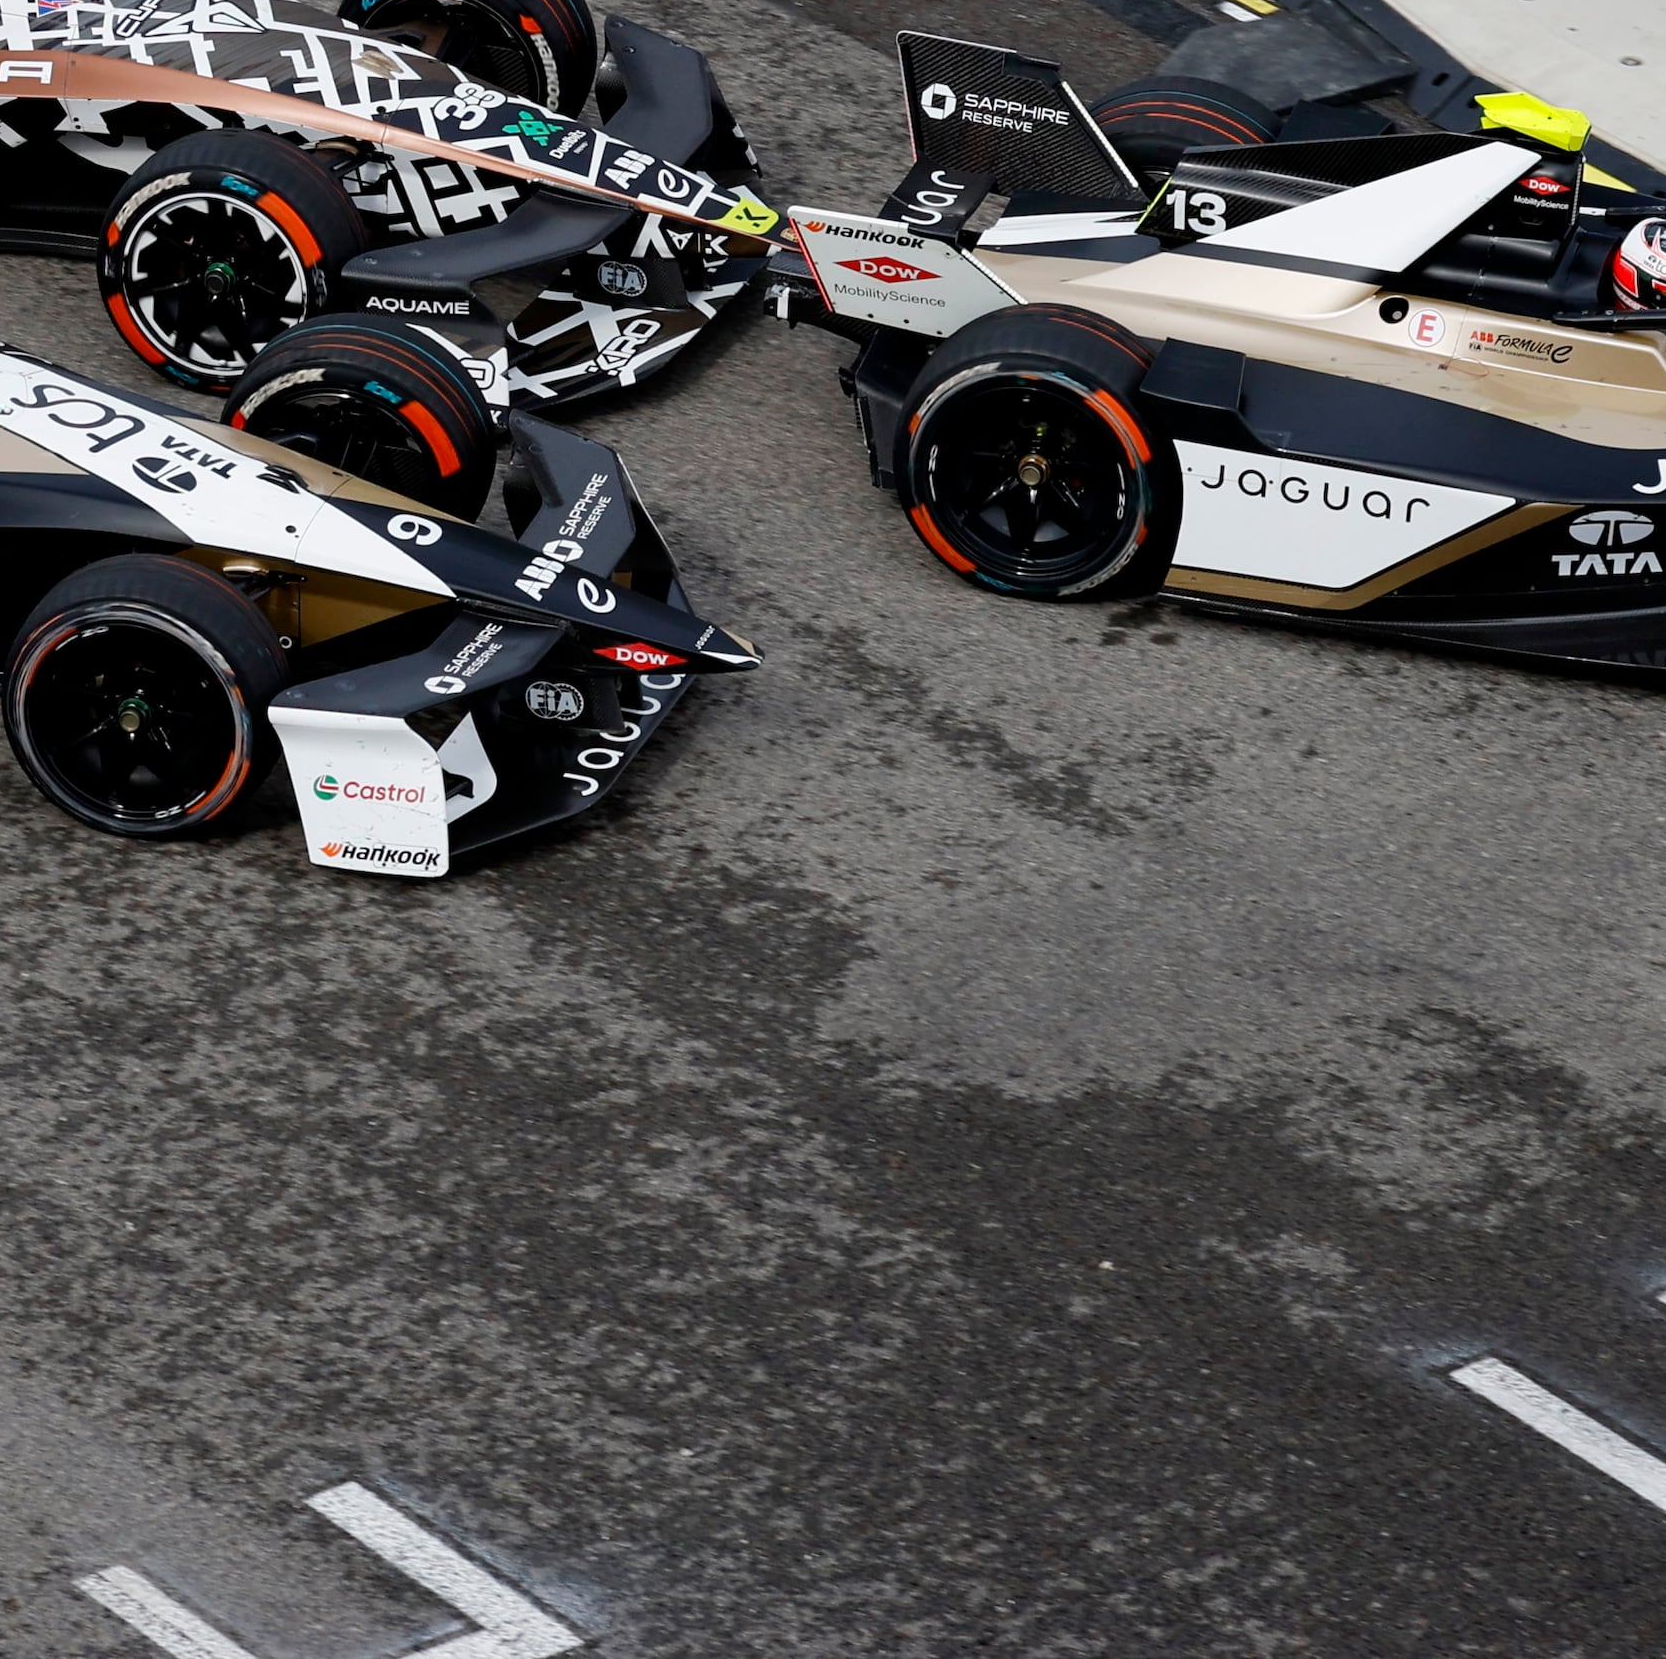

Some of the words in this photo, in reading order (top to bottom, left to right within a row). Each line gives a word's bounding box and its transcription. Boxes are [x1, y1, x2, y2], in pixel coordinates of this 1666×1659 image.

[433, 80, 508, 131] 33
[961, 109, 1034, 134] RESERVE
[963, 92, 1071, 126] SAPPHIRE
[1165, 188, 1227, 236] 13
[365, 296, 471, 315] AQUAME
[833, 283, 947, 309] MobilityScience
[1417, 315, 1436, 343] E
[1469, 330, 1494, 343] ABB
[1494, 333, 1554, 356] FORMULA
[159, 434, 238, 480] TATA
[559, 472, 609, 537] SAPPHIRE
[577, 494, 612, 540] RESERVE
[1551, 553, 1664, 577] TATA
[443, 621, 504, 675] SAPPHIRE
[461, 642, 503, 678] RESERVE
[343, 781, 426, 804] Castrol
